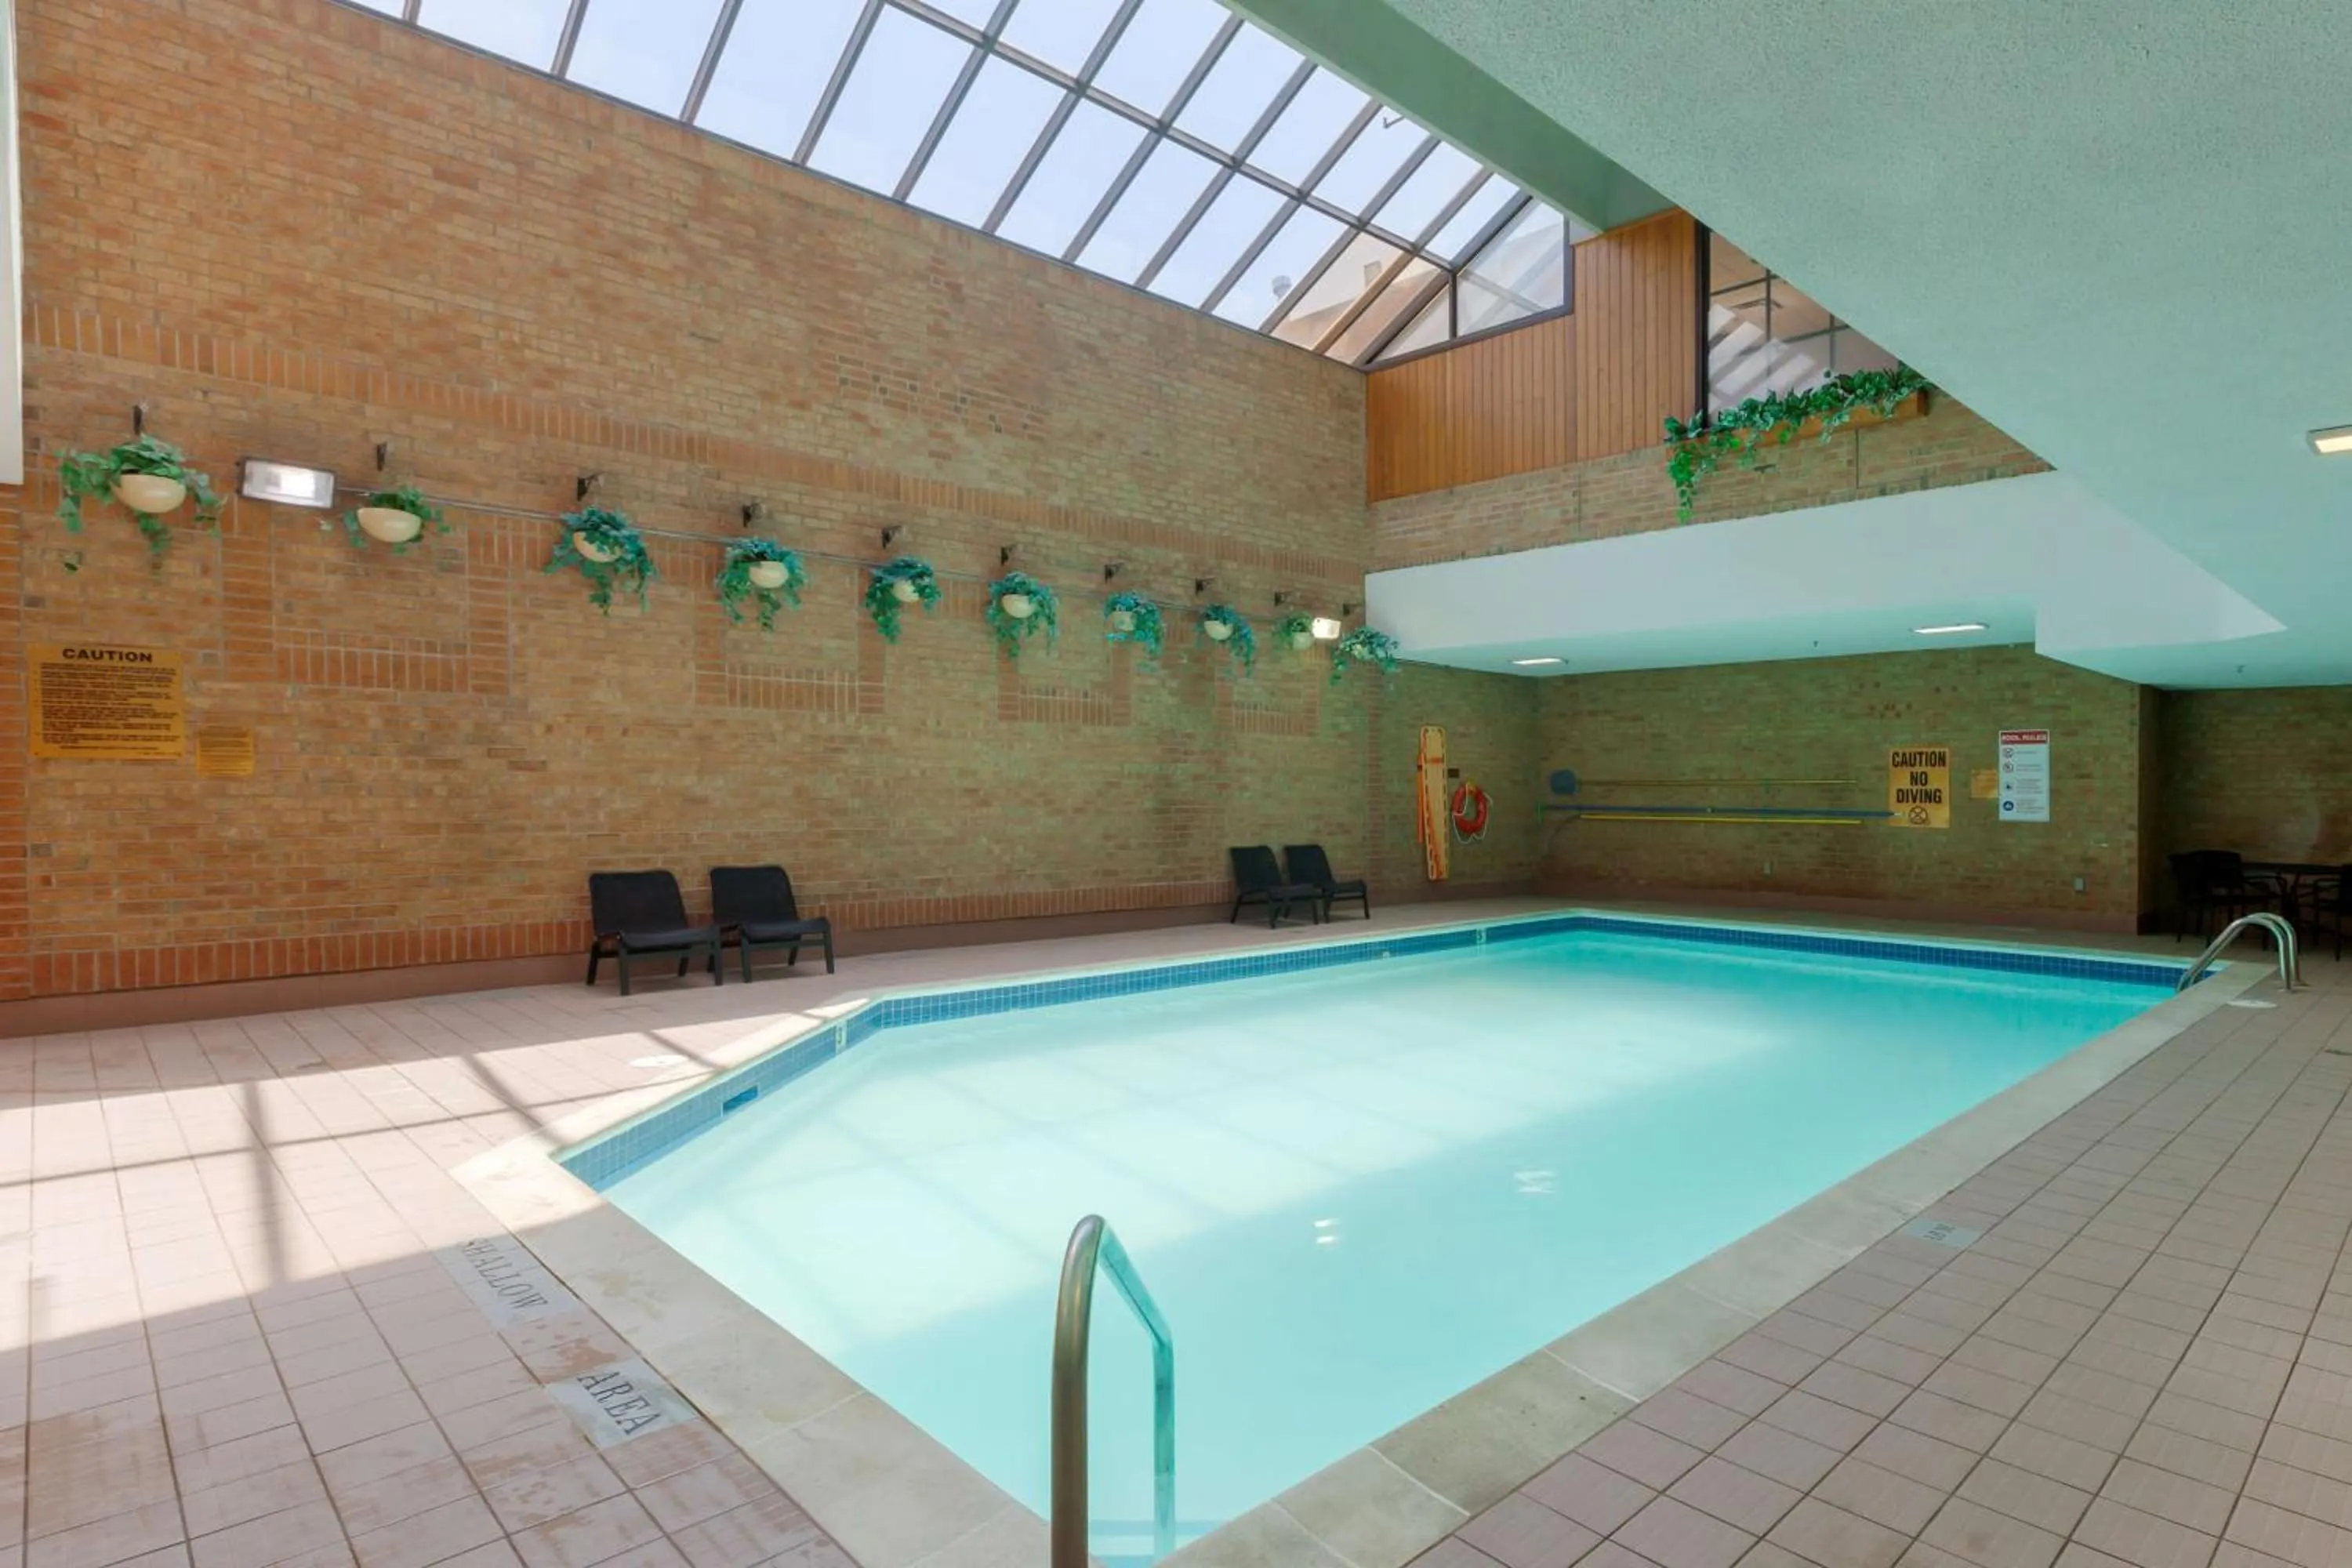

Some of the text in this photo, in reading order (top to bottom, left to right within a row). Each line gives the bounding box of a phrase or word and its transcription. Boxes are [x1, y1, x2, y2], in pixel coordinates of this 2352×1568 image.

[62, 648, 153, 663] CAUTION
[1892, 750, 1947, 768] CAUTION
[1910, 771, 1928, 786] NO
[1896, 788, 1943, 804] DIVING
[576, 1371, 662, 1435] AREA
